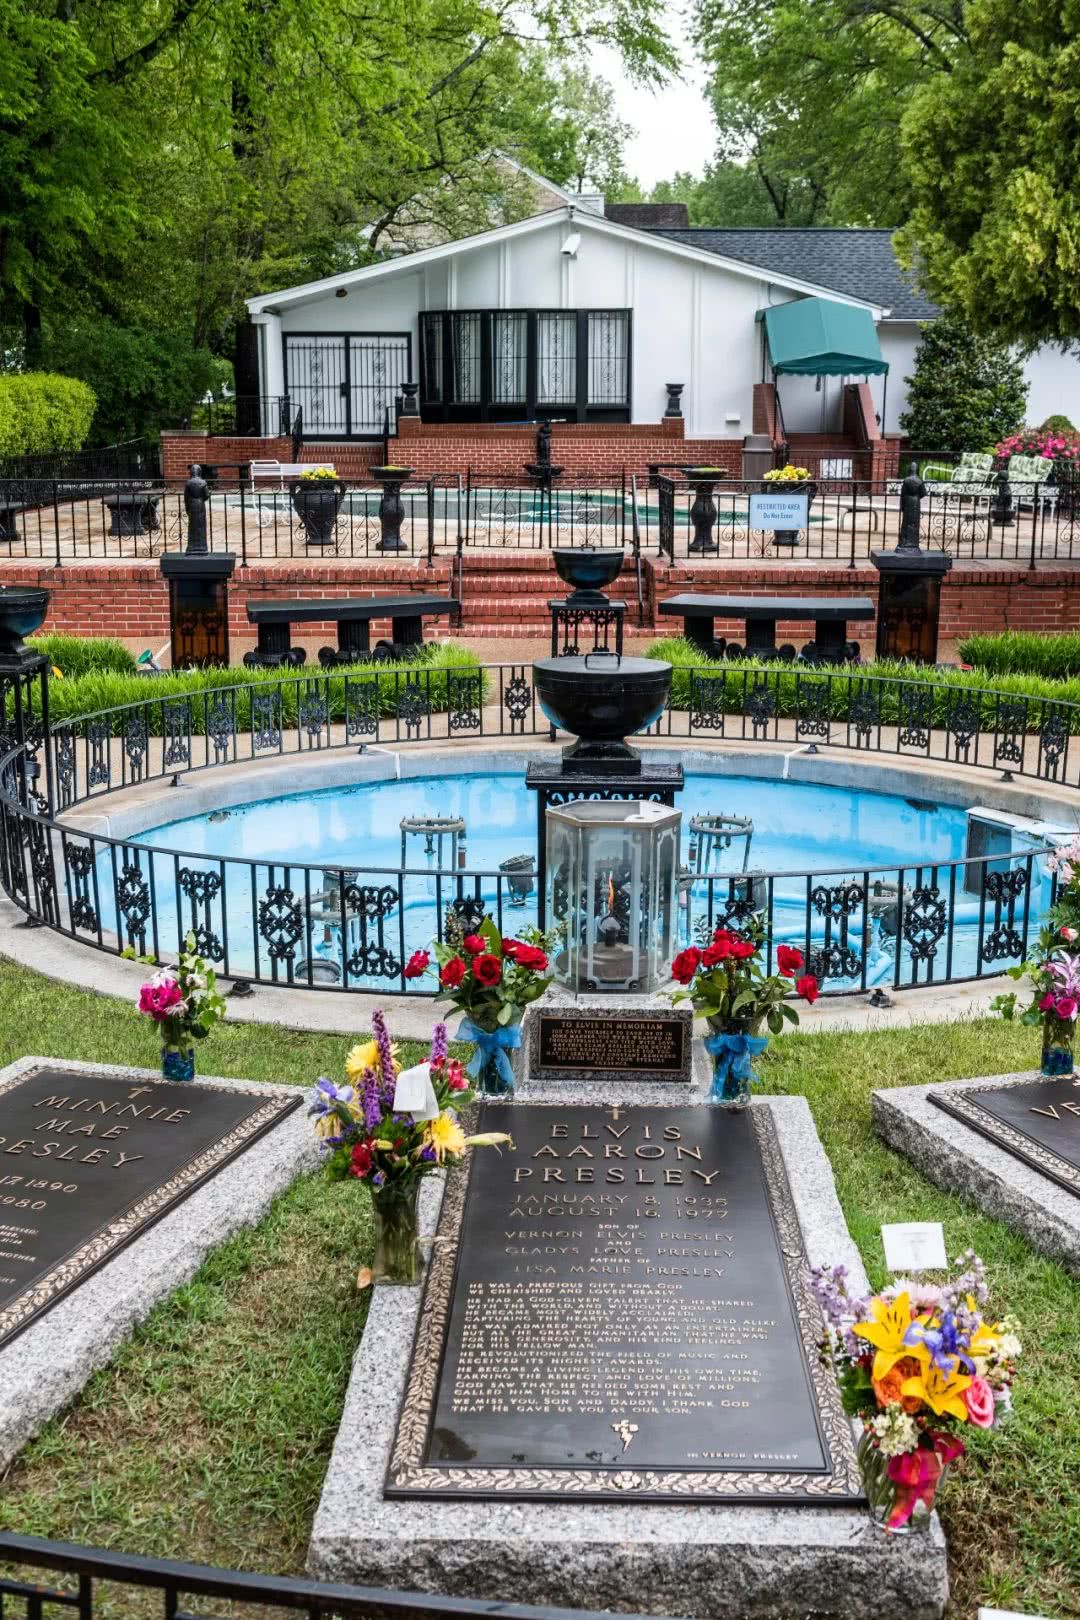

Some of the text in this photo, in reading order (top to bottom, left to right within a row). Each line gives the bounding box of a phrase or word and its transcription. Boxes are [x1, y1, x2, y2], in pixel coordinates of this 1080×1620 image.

[616, 1022, 663, 1030] MEMORIAM
[32, 1095, 192, 1123] MINNIE
[33, 1118, 129, 1140] MAE
[551, 1124, 682, 1140] ELVIS
[532, 1144, 702, 1161] AARON
[514, 1167, 720, 1185] PRESLEY
[25, 1179, 78, 1193] 1890
[514, 1194, 629, 1204] JANUARY
[676, 1196, 728, 1206] 1935
[510, 1207, 618, 1217] AUGUST
[676, 1210, 728, 1219] 1977
[504, 1230, 735, 1242] VERNON ELVIS PRESLEY
[504, 1247, 735, 1258] GLADYS LOVE PRESLEY
[514, 1265, 725, 1277] LISA MARIE PRESLEY
